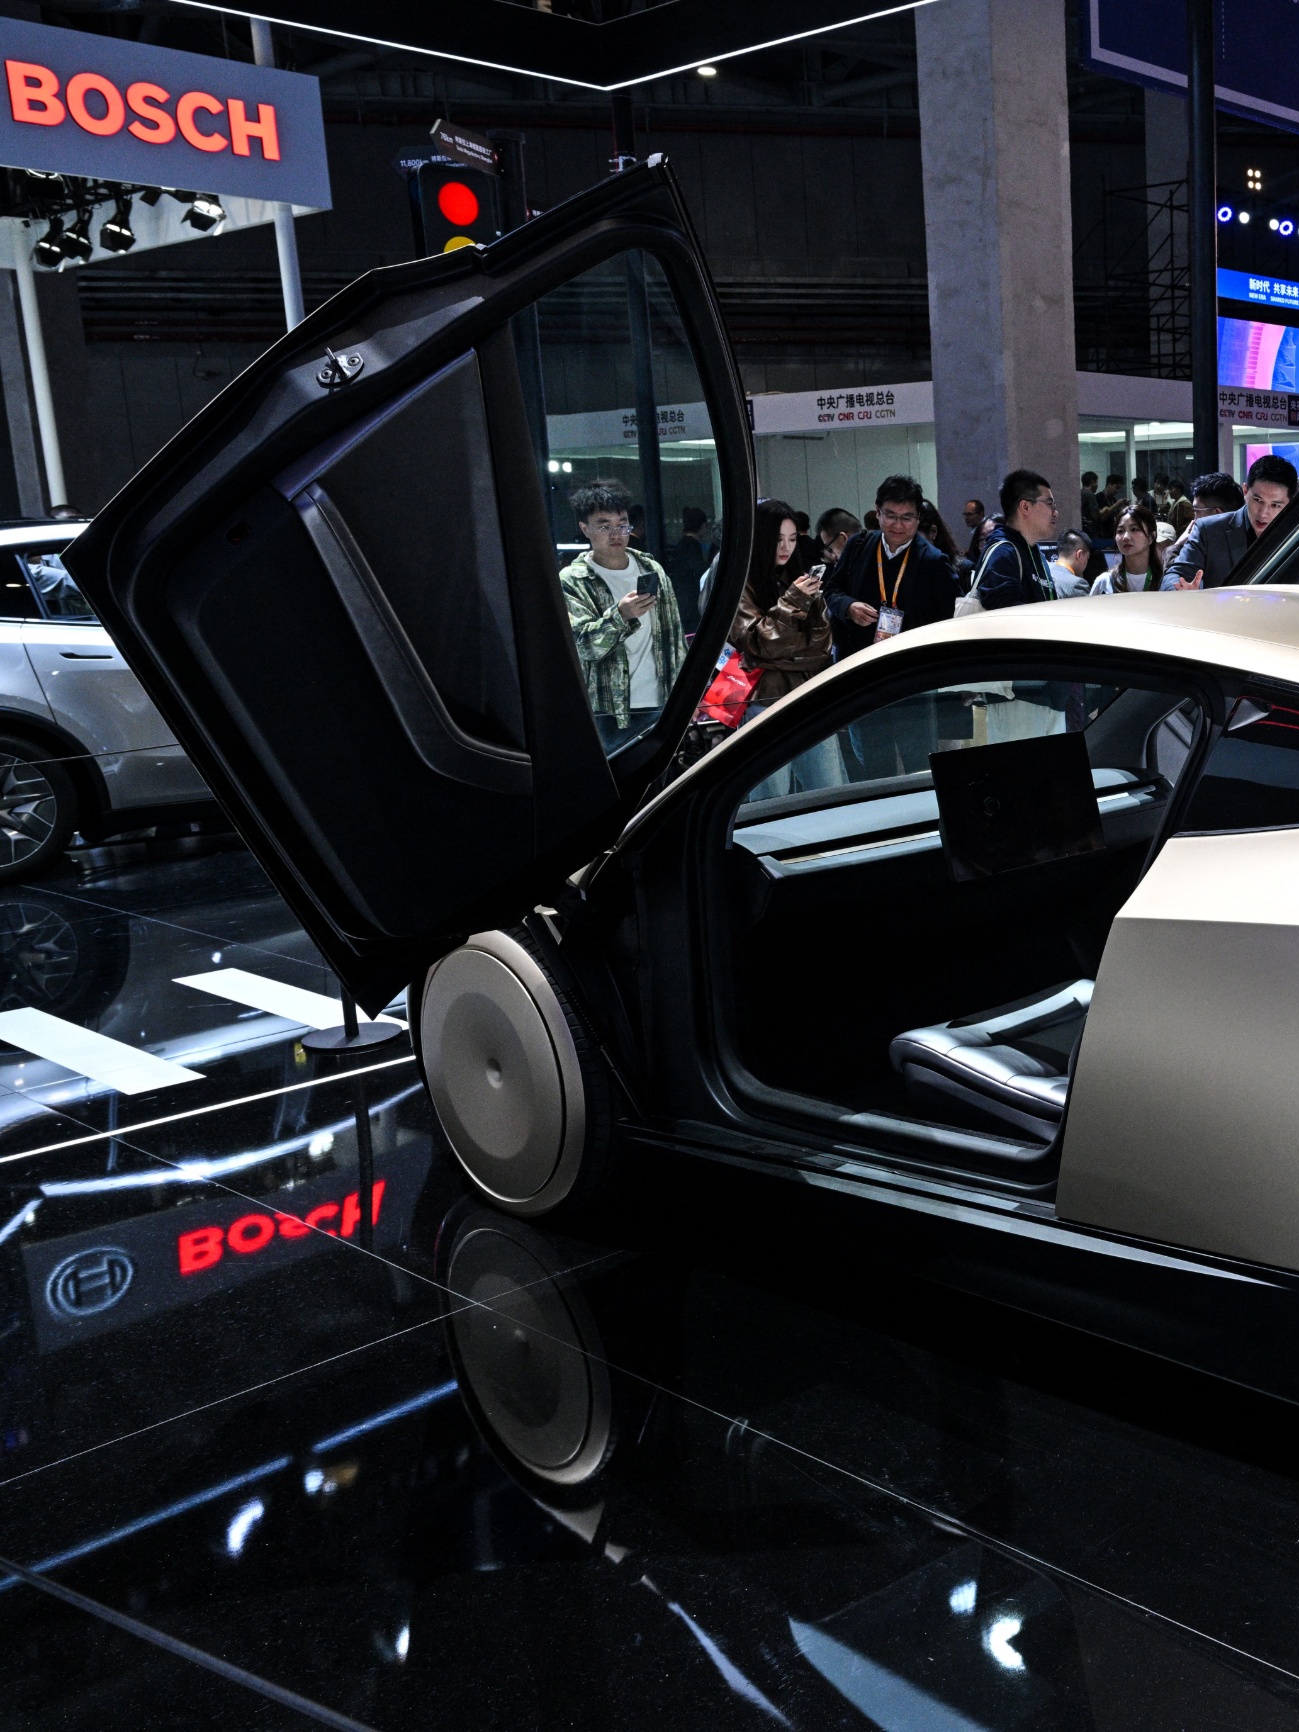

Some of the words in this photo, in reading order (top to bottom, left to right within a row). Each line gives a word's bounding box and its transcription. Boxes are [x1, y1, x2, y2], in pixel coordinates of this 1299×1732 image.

[5, 59, 281, 161] BOSCH
[1249, 278, 1270, 293] 新时代
[1273, 283, 1299, 297] 共享未来
[817, 390, 895, 410] 中央广播电视总台
[1220, 391, 1287, 410] 中央广播电视总台
[622, 409, 685, 427] 中央视总台
[838, 411, 855, 421] CNR
[874, 408, 896, 419] CGTN
[1271, 413, 1288, 422] CGTN
